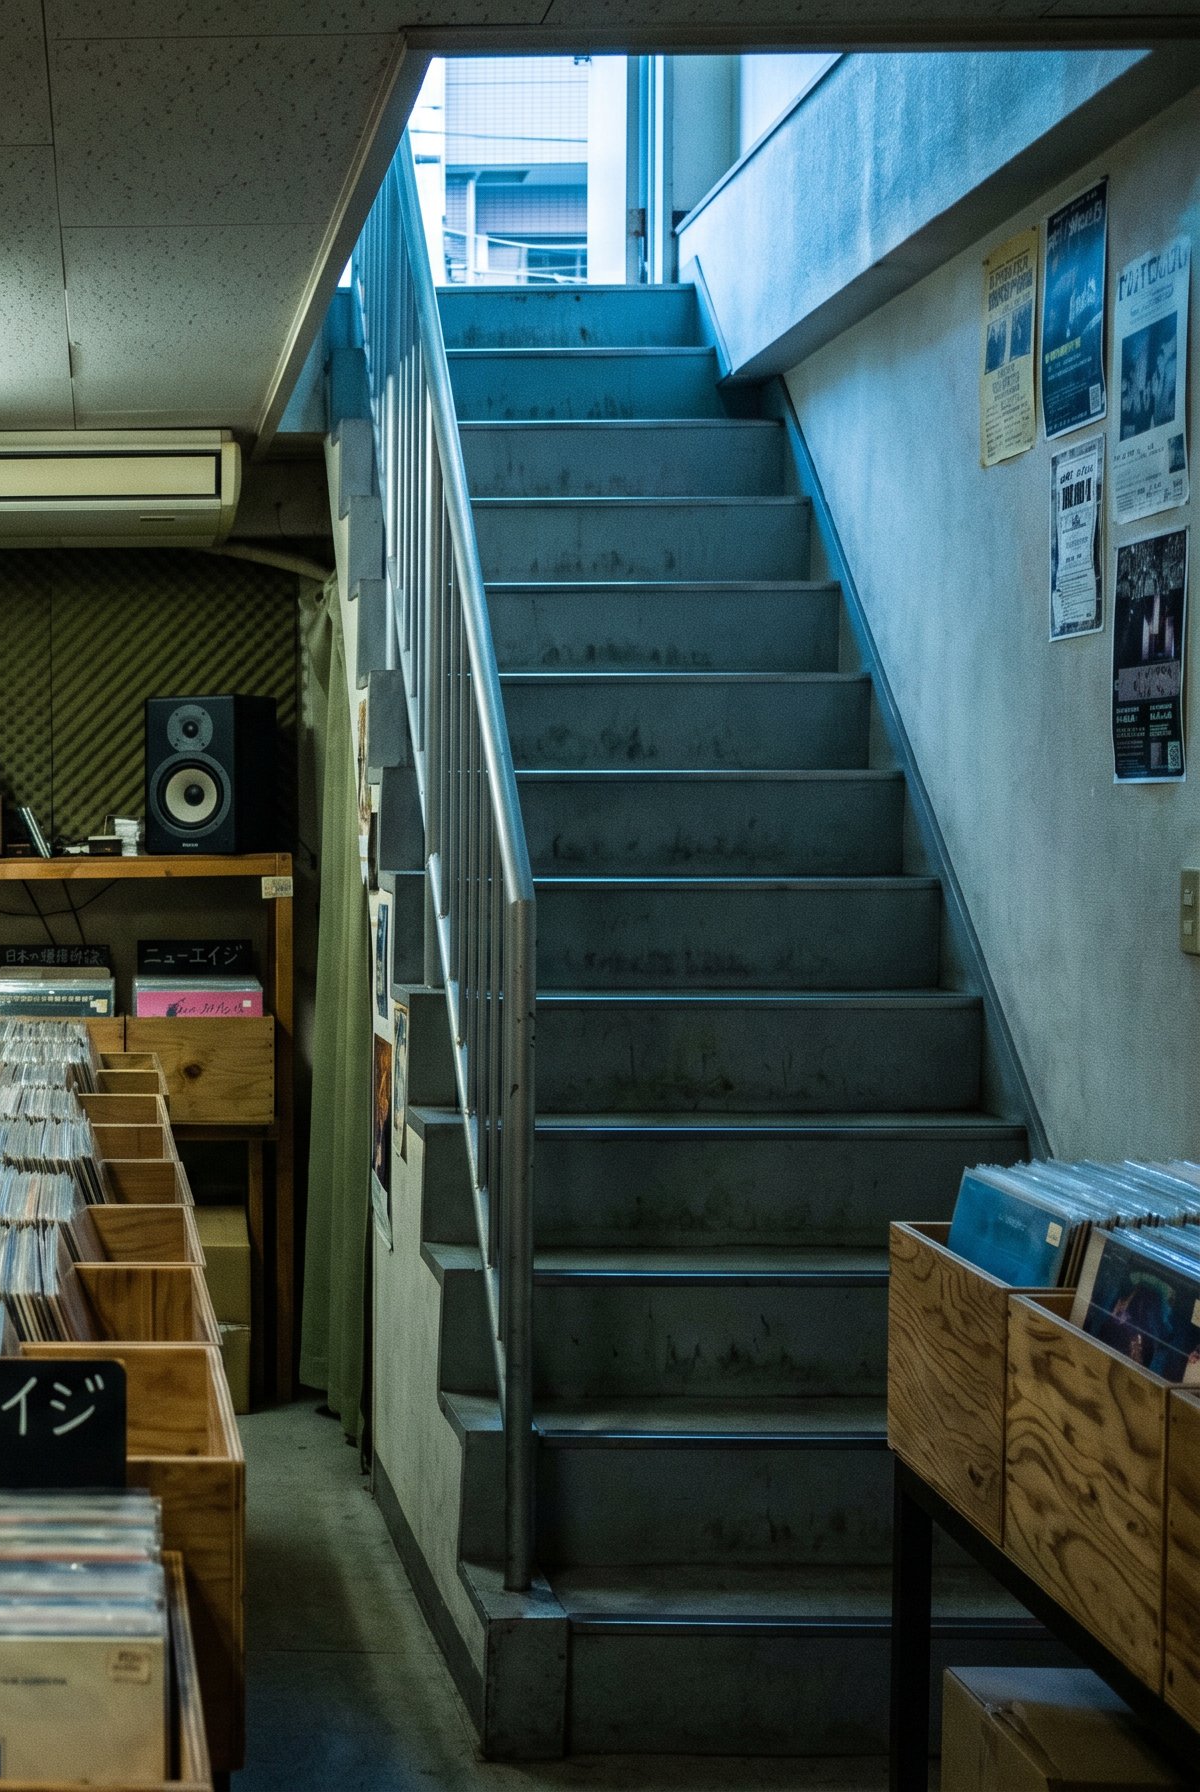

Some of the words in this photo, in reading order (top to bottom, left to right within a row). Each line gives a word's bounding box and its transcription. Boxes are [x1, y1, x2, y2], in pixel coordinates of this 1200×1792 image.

[144, 945, 243, 966] ニューエイジ
